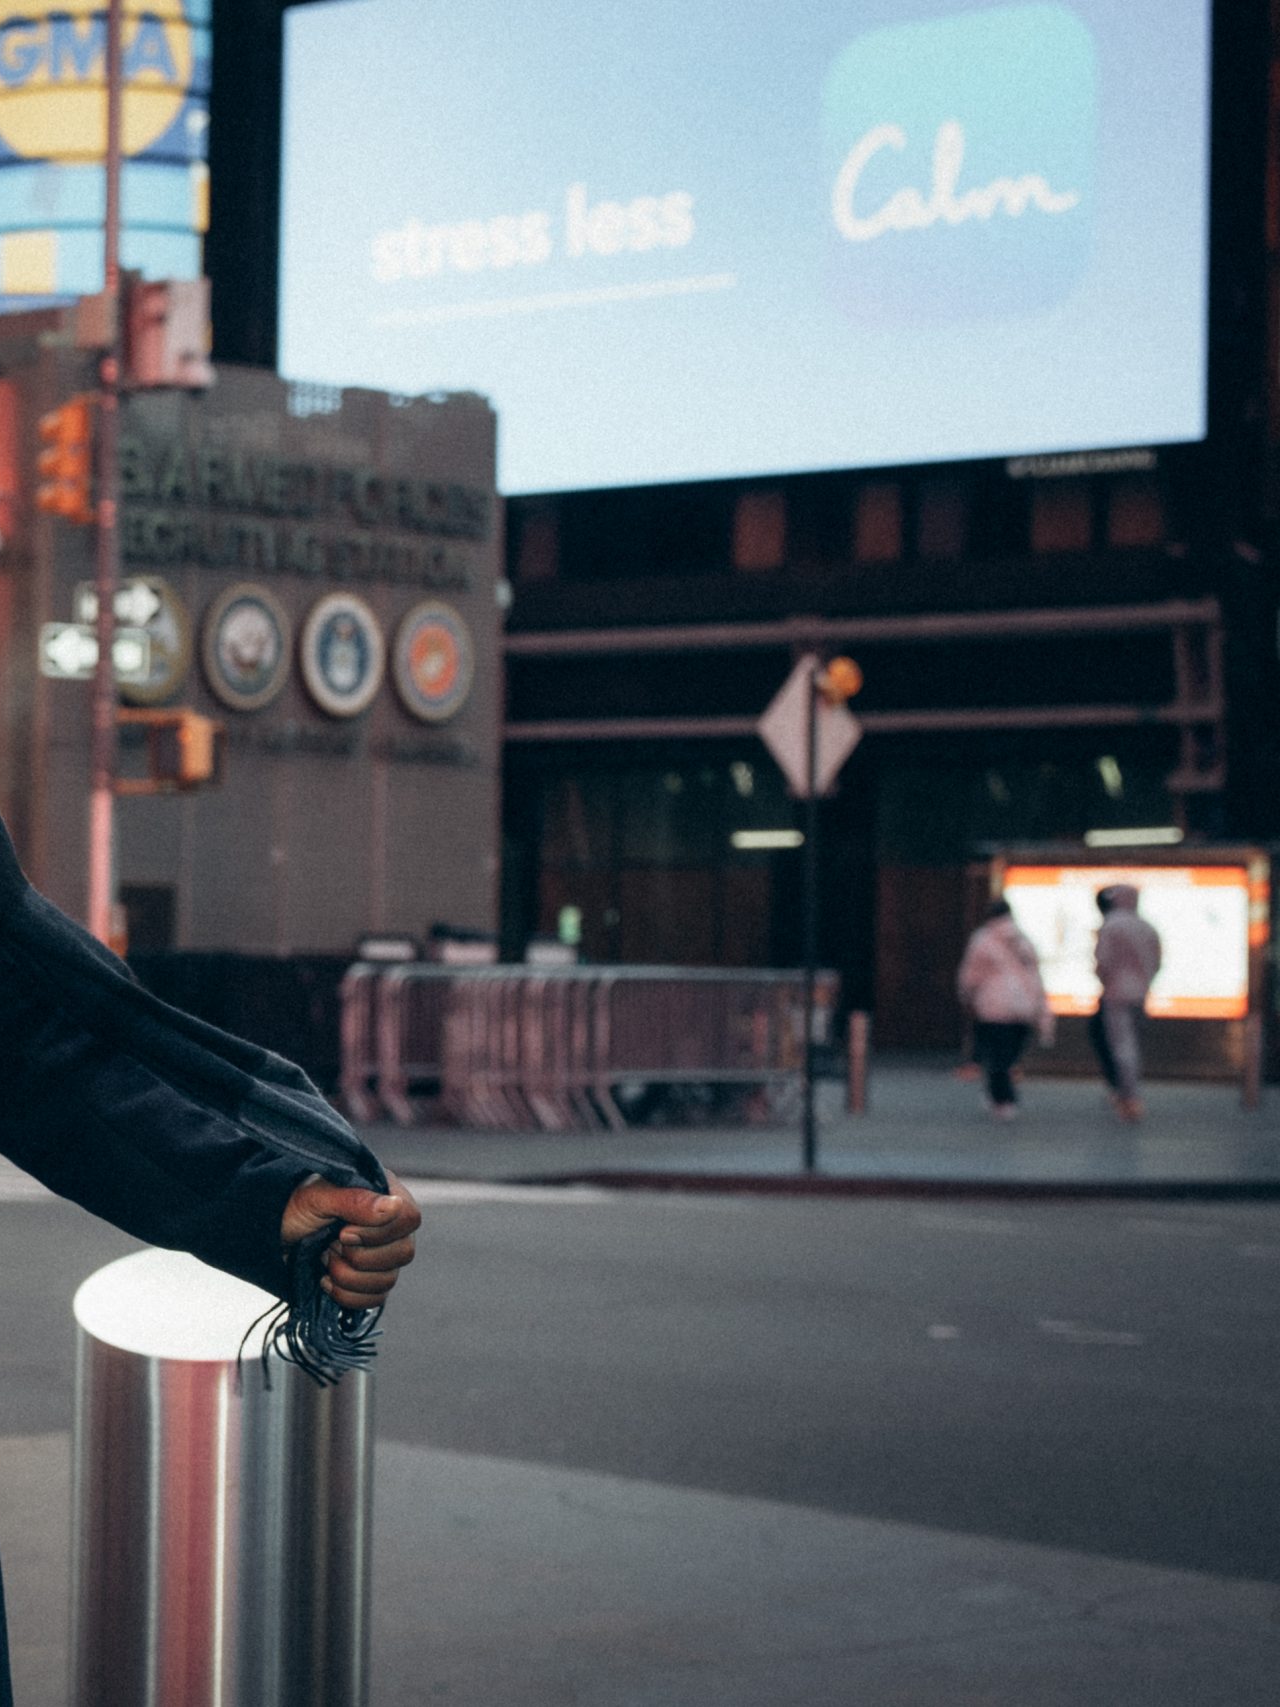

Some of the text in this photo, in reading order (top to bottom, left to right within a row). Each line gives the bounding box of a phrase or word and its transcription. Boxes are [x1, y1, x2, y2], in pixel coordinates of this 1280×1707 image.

[371, 180, 696, 282] stress less
[831, 119, 1081, 242] Calm
